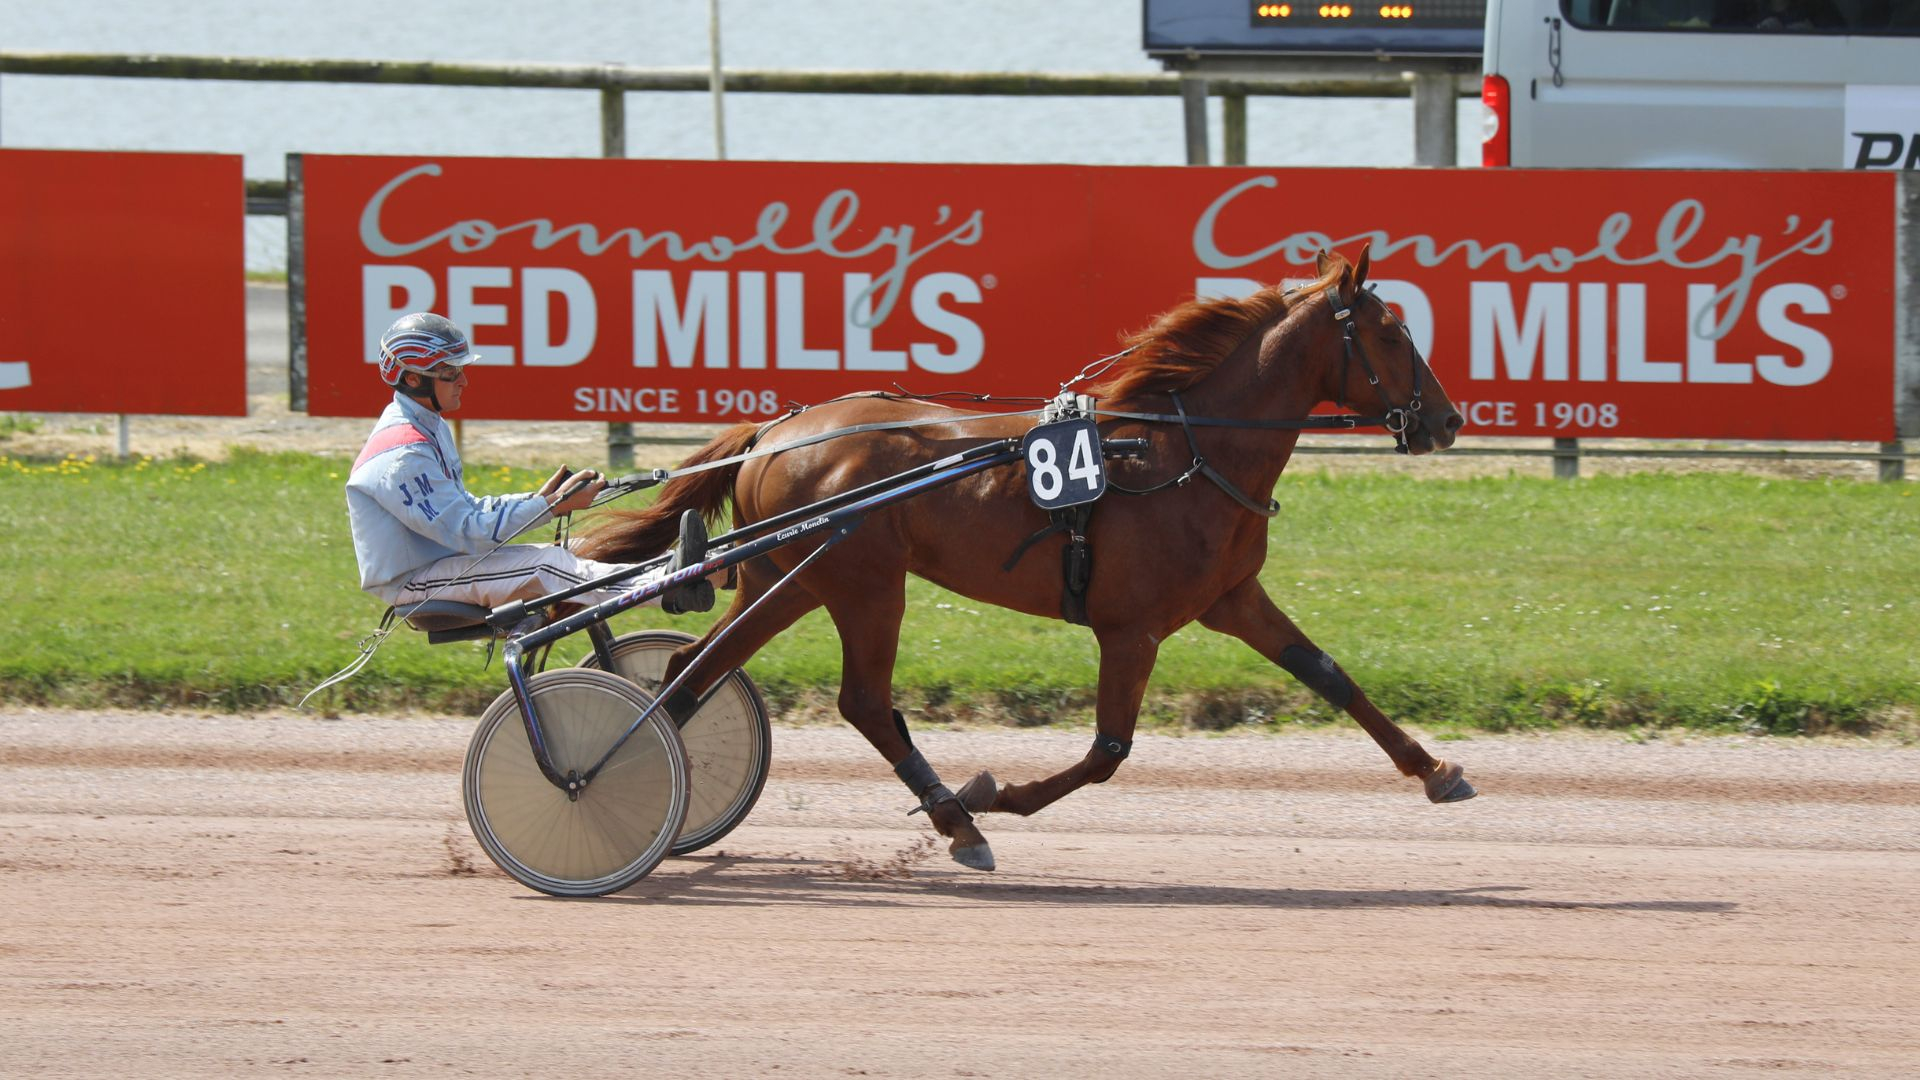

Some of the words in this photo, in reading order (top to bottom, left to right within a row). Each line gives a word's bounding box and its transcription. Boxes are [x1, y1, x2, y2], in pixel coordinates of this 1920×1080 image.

[1851, 132, 1920, 169] P
[359, 163, 984, 329] Connolly's
[1193, 175, 1833, 341] Connolly's
[574, 387, 680, 413] SINCE
[696, 389, 779, 416] 1908
[1534, 402, 1619, 430] 1908
[1028, 428, 1100, 500] 84
